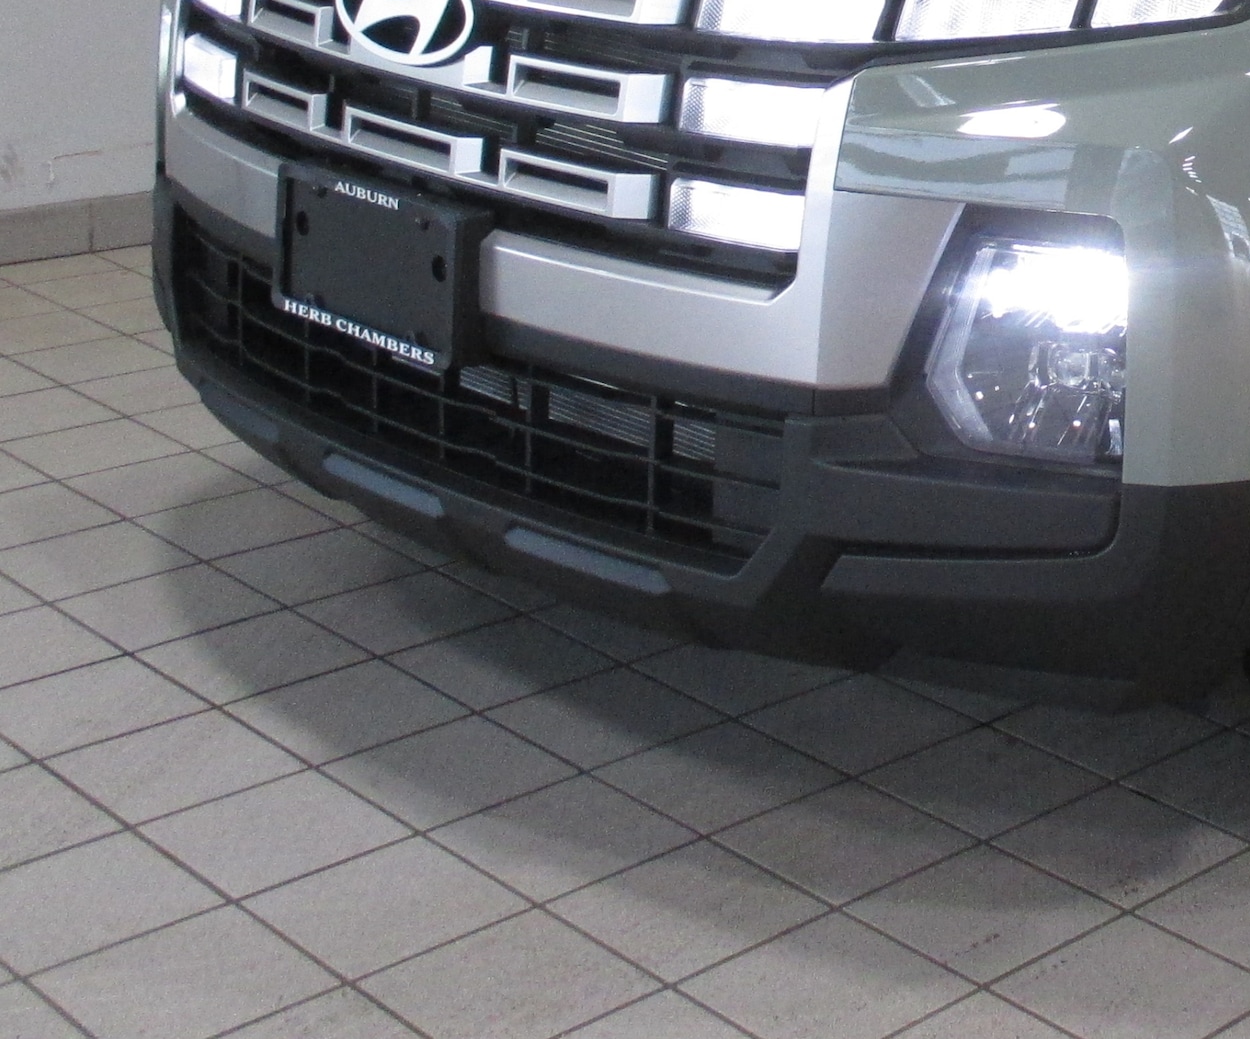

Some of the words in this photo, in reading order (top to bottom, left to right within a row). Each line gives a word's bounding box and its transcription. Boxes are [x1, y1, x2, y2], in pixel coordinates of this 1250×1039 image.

[334, 181, 400, 211] AUBURN
[284, 299, 332, 327] HERB
[335, 318, 435, 365] CHAMBERS
